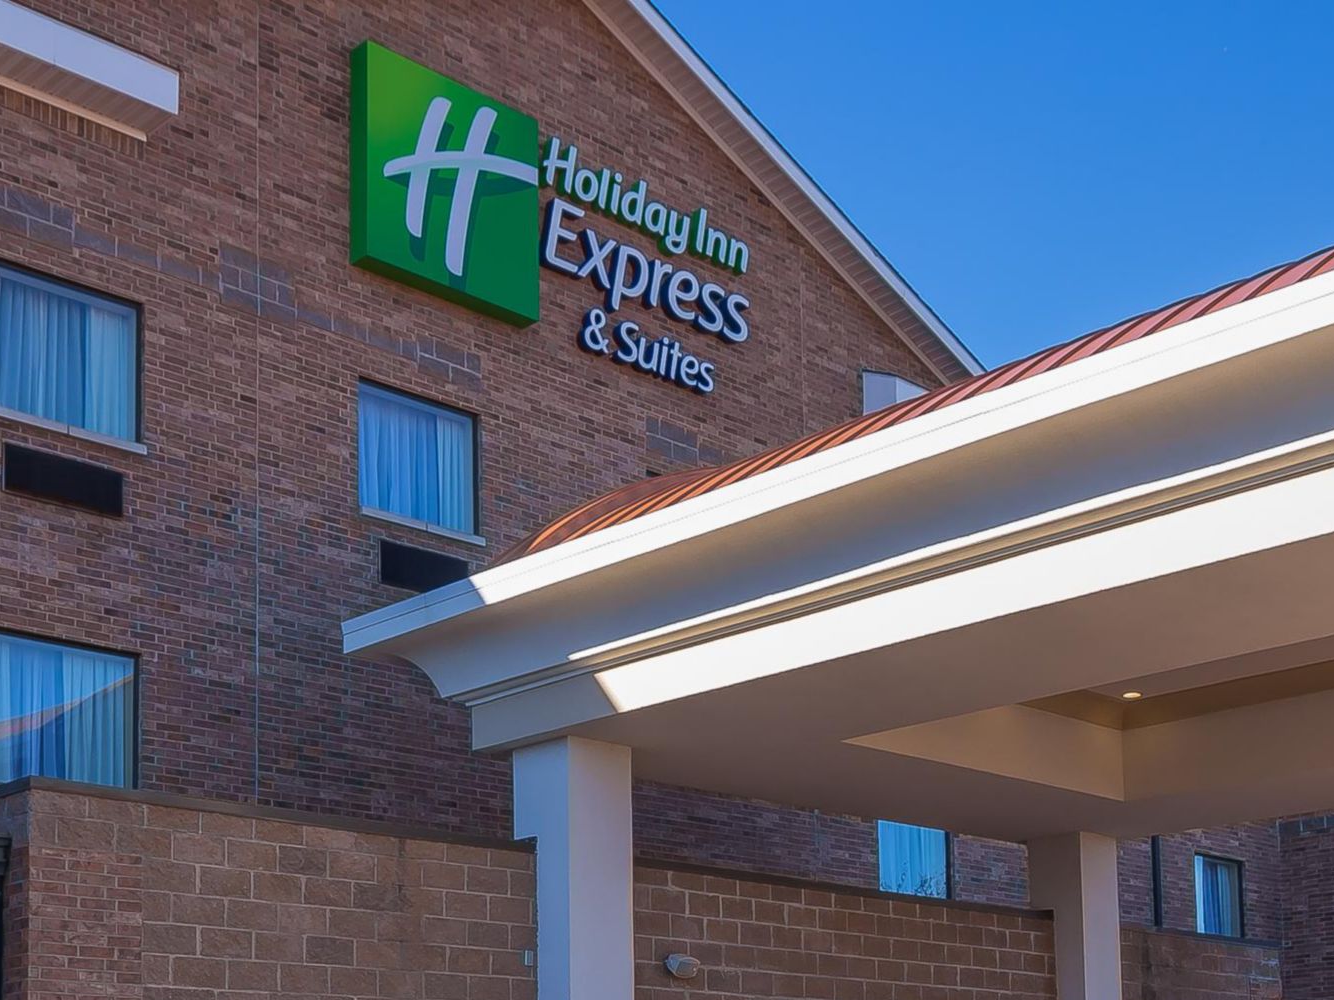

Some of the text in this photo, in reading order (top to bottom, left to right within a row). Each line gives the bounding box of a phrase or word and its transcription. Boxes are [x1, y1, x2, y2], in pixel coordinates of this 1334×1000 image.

[542, 136, 750, 273] Holiday Inn
[544, 198, 751, 342] Express
[581, 308, 715, 394] & Suites
